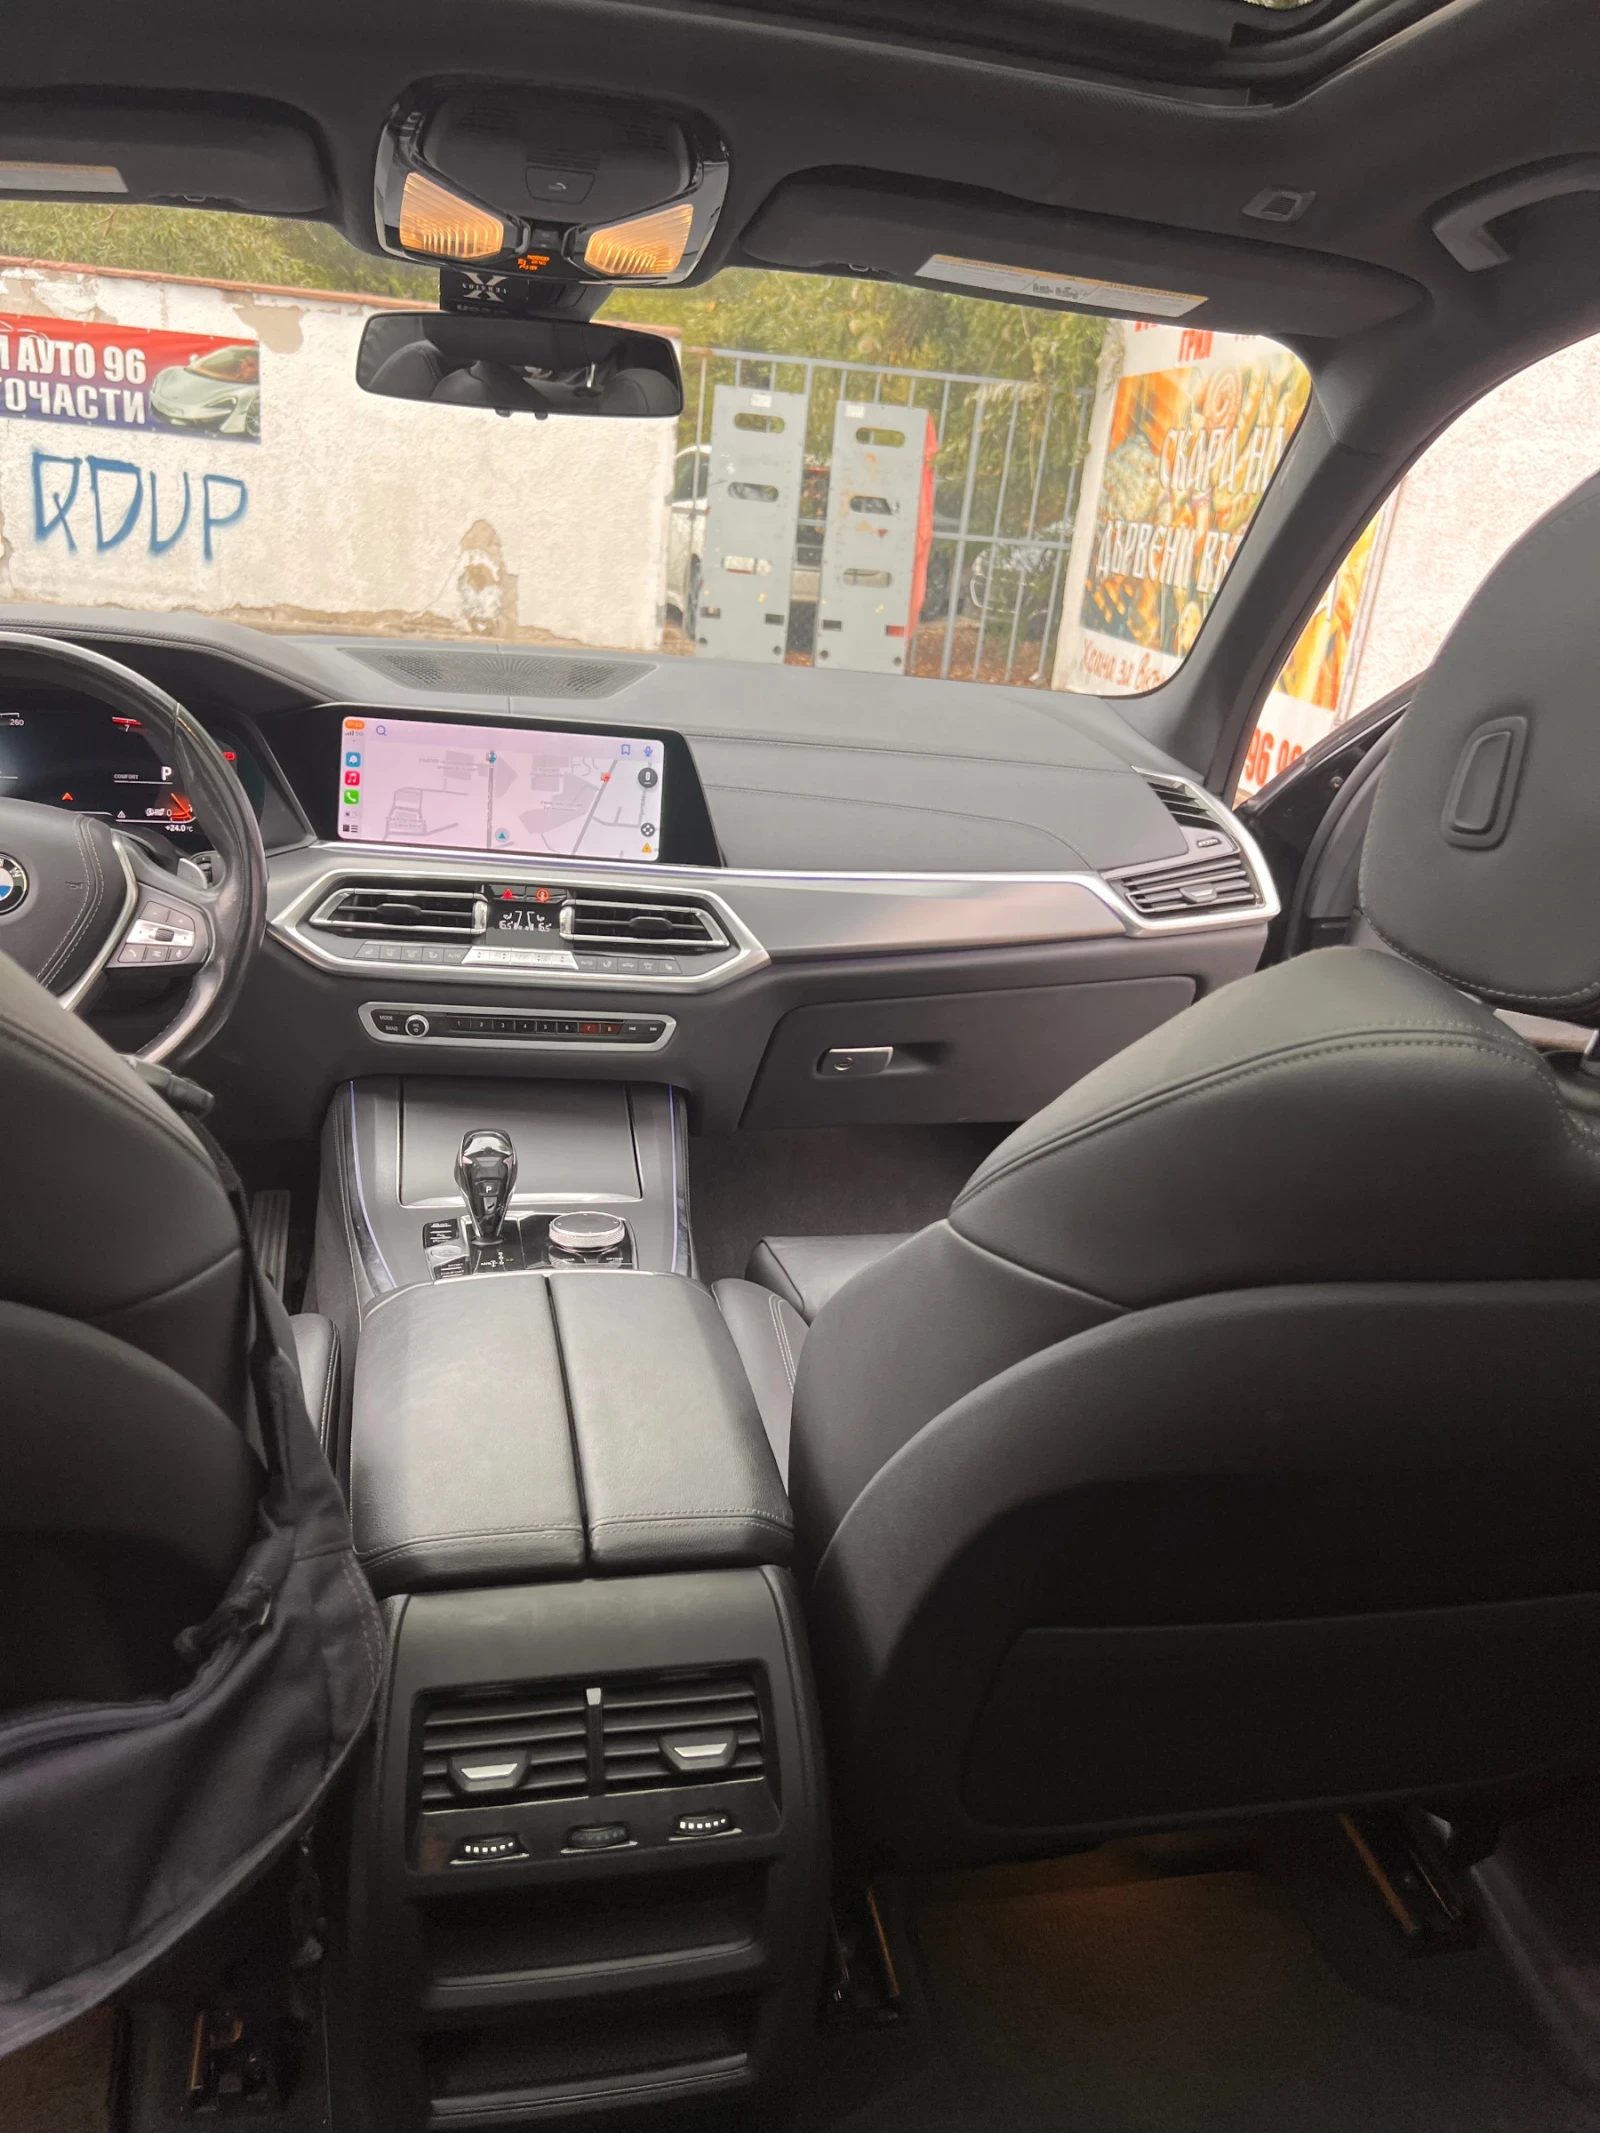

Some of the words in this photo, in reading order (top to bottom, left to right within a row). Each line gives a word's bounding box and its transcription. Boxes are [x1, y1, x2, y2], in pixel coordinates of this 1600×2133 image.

[17, 336, 96, 379] АУТО
[103, 346, 147, 384] 96
[0, 377, 146, 425] ОЧАСТИ
[1160, 427, 1240, 493] СКАРА
[1197, 531, 1245, 593] ВЪ
[10, 718, 25, 726] 260
[124, 724, 131, 732] 7
[161, 766, 173, 781] P
[1245, 728, 1274, 786] 96
[485, 1185, 492, 1193] P
